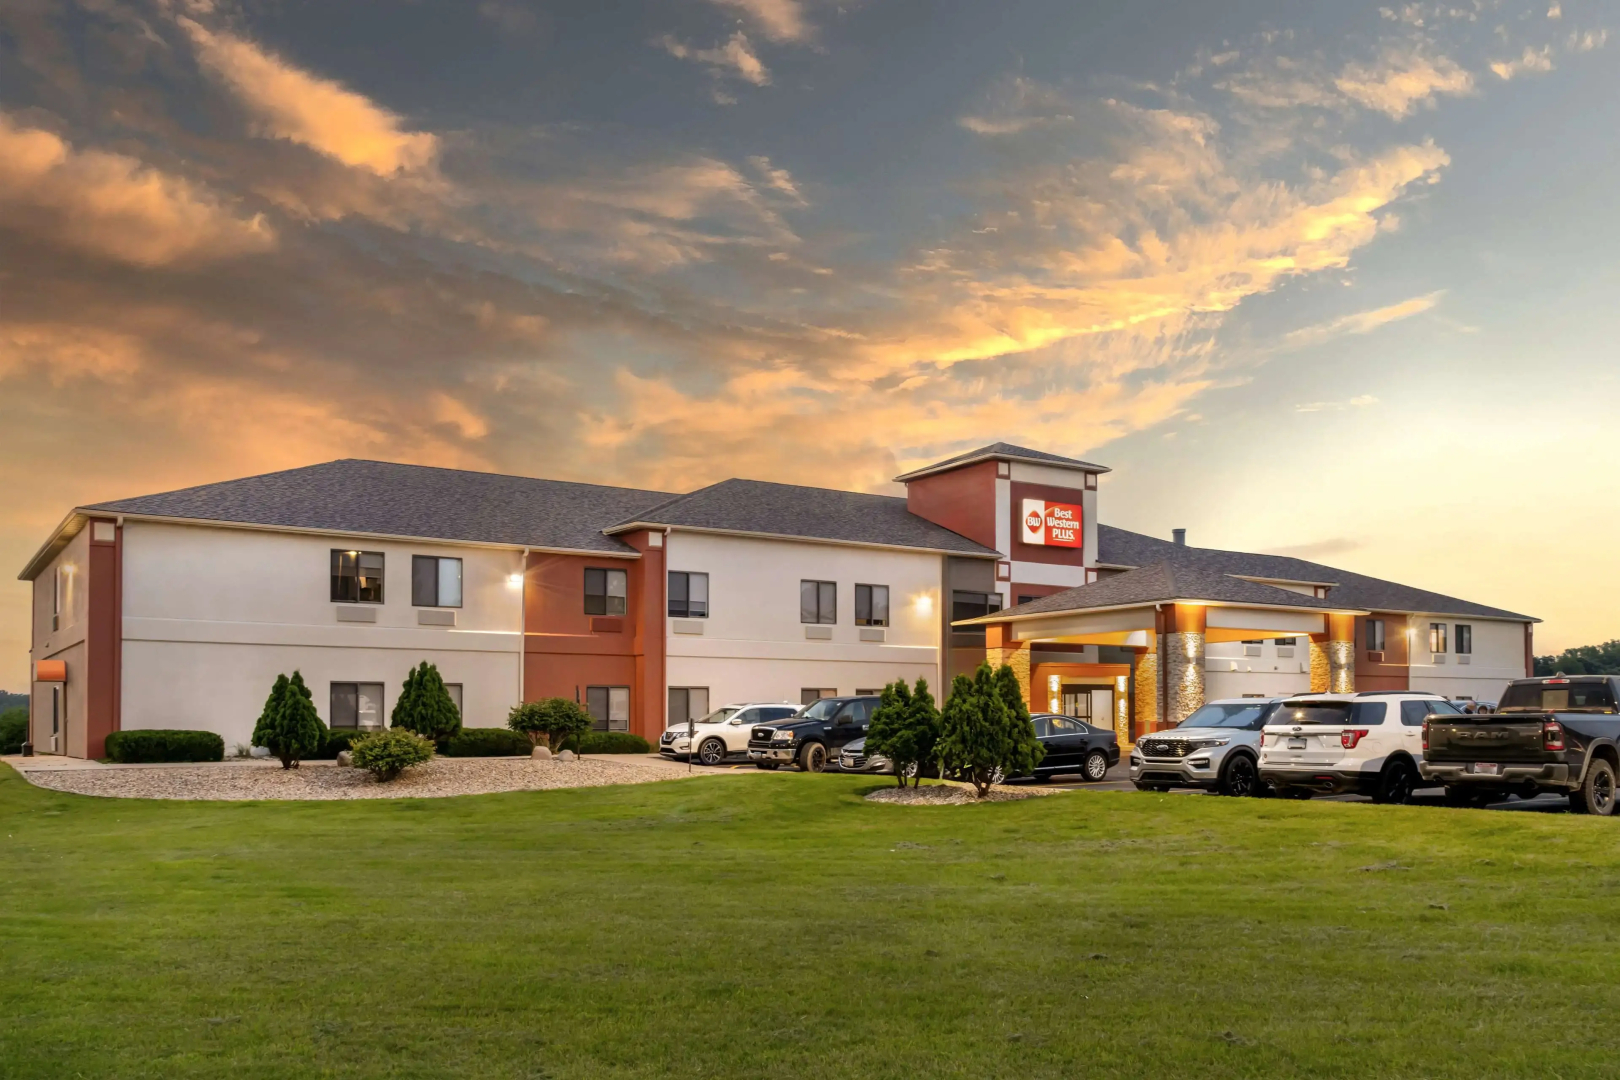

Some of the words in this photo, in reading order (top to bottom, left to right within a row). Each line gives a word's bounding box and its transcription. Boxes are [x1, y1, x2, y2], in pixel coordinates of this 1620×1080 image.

[1054, 507, 1072, 519] Best
[1027, 516, 1041, 527] BW
[1046, 517, 1079, 529] Western
[1052, 528, 1075, 539] PLUS
[1456, 731, 1509, 739] RAM
